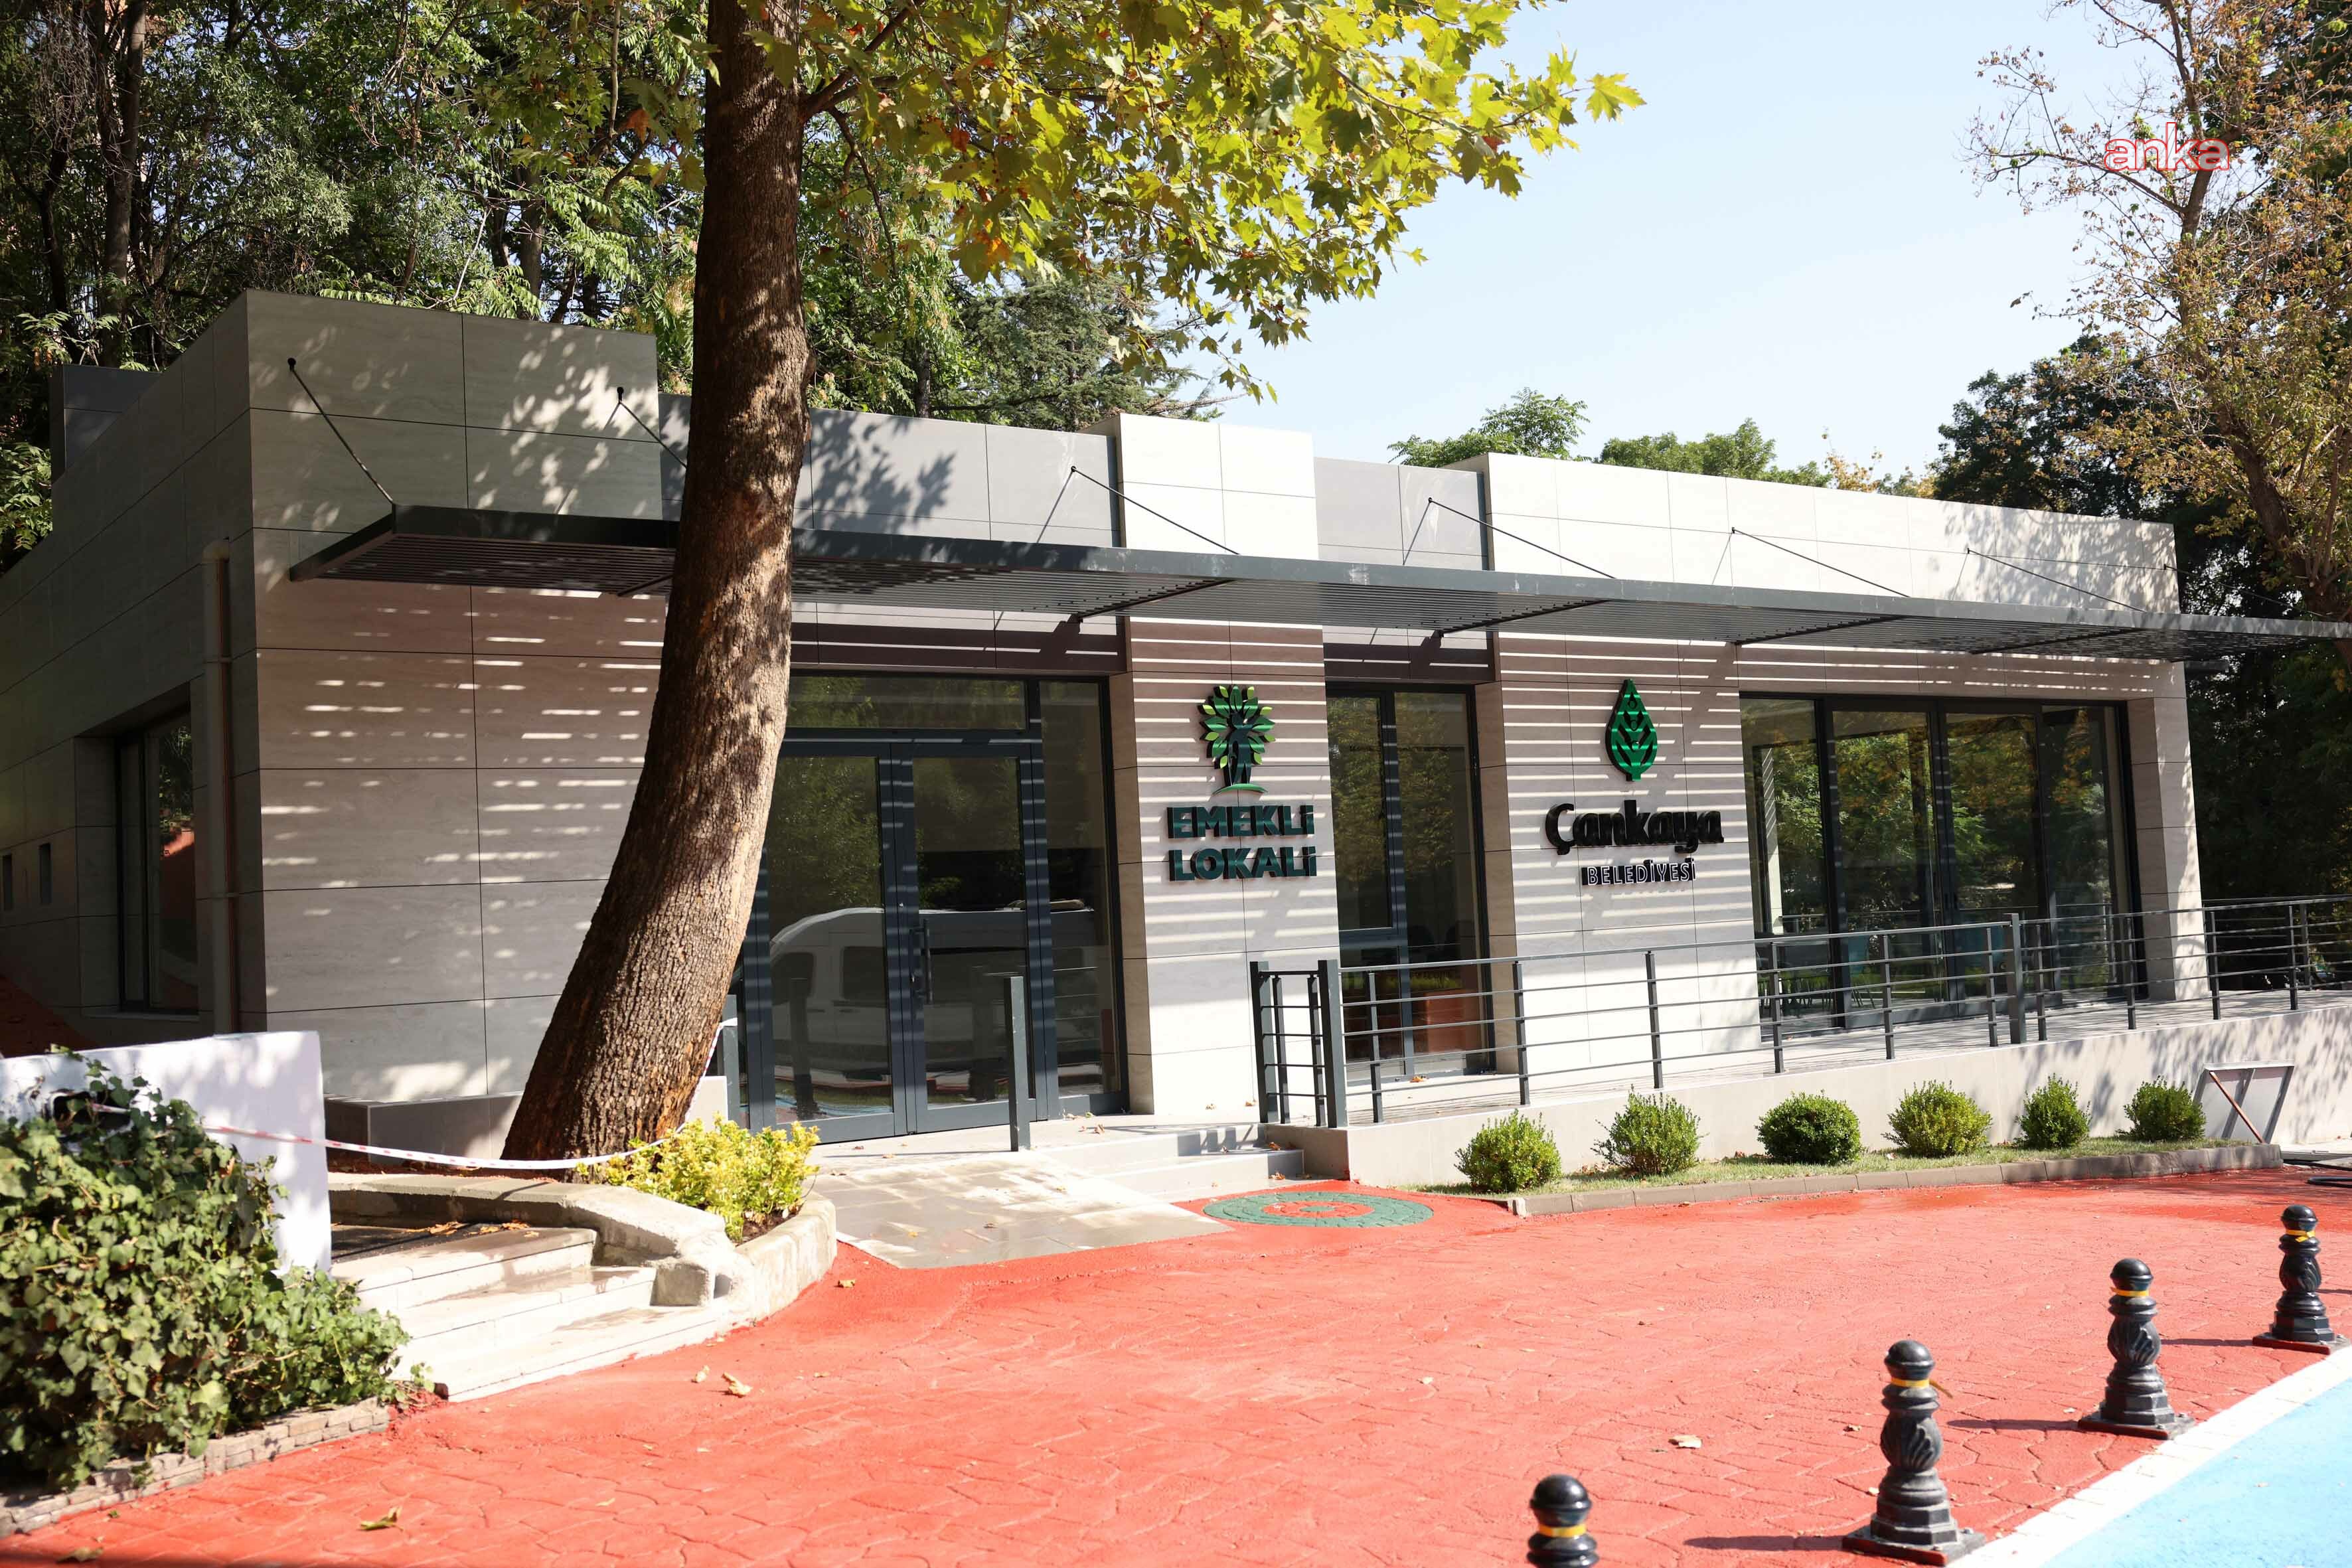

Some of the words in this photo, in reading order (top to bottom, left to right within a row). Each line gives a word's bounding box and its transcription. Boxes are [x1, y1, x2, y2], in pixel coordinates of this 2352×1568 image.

[1166, 805, 1314, 838] EMEKLİ
[1545, 799, 1724, 855] Çankaya
[1168, 846, 1316, 882] LOKALİ
[1585, 858, 1696, 886] BELEDİYESİ
